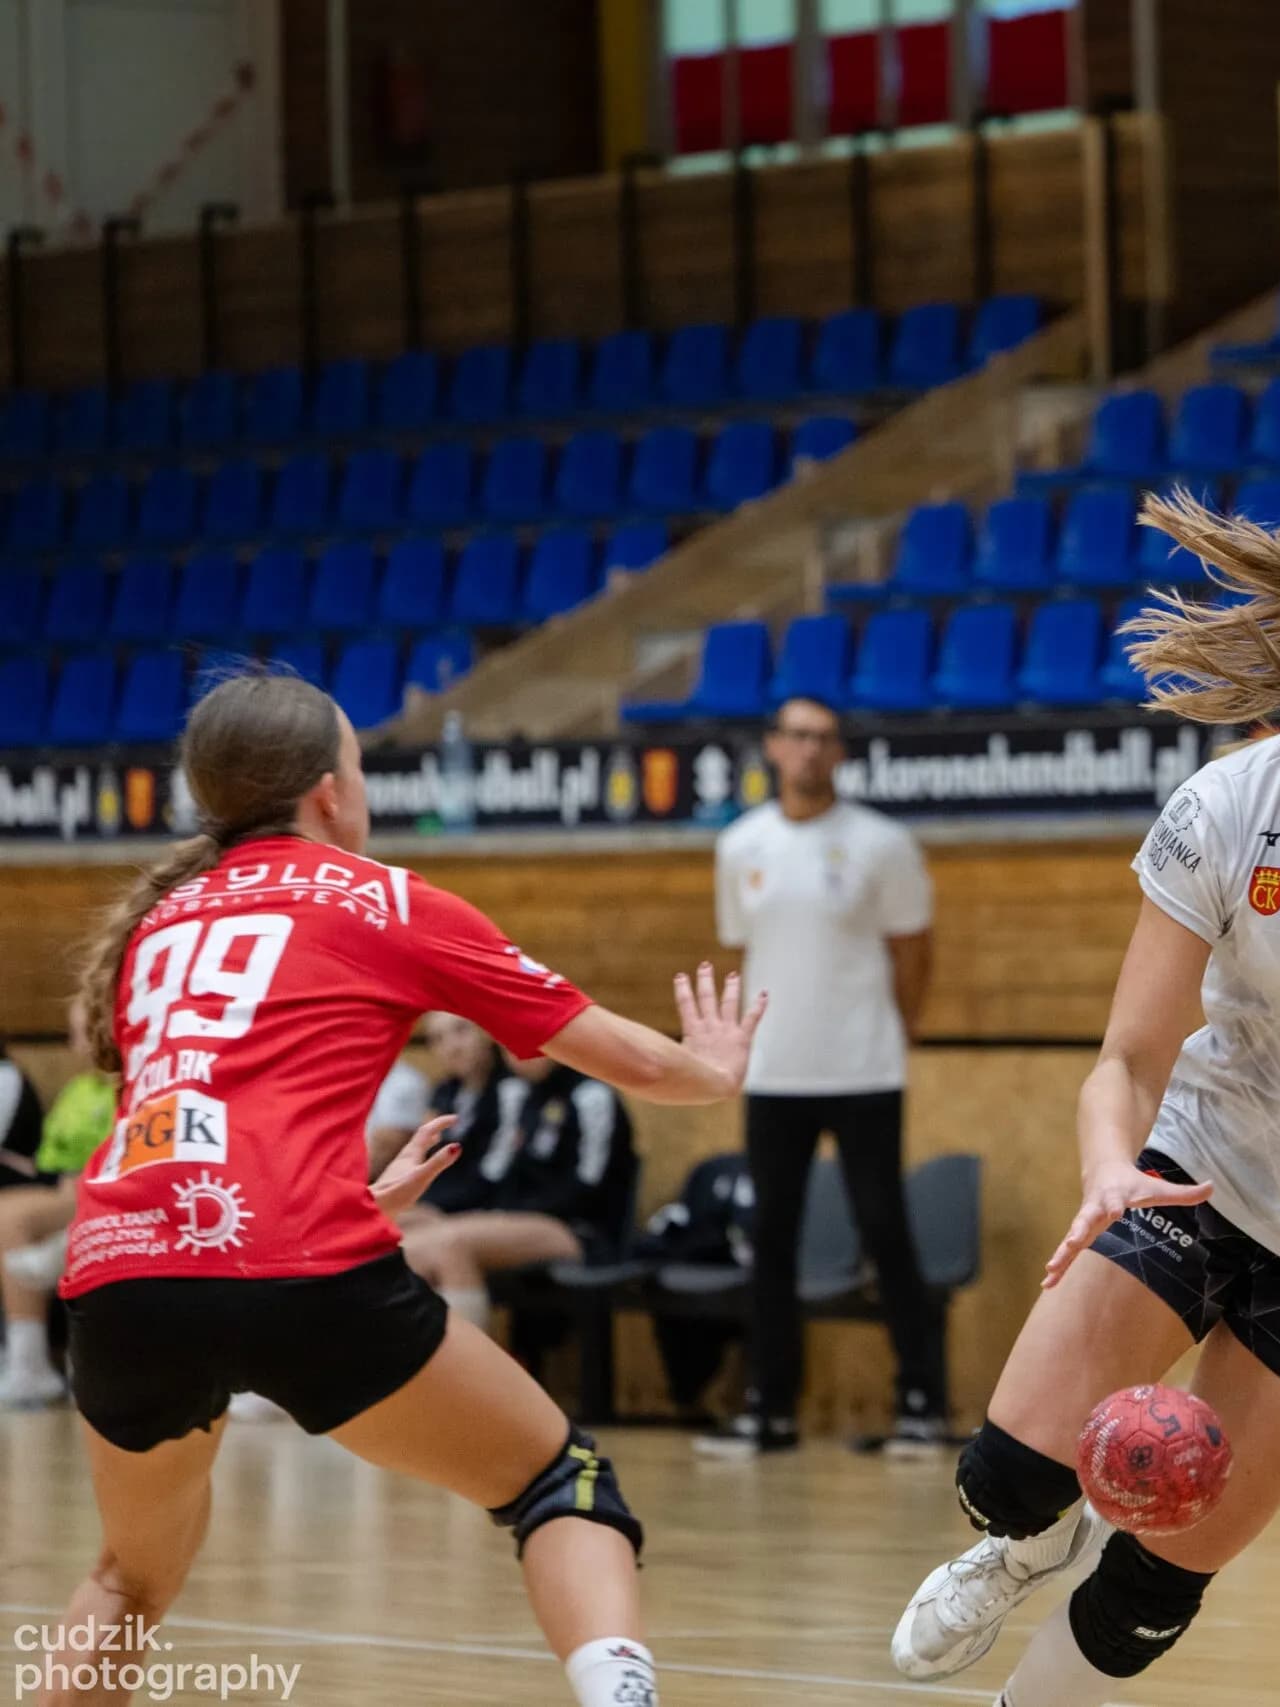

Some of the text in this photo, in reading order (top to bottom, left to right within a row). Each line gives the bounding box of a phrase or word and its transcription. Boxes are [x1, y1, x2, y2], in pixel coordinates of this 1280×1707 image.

[291, 890, 388, 930] TEAM
[1252, 885, 1277, 910] CK
[126, 913, 294, 1082] 99
